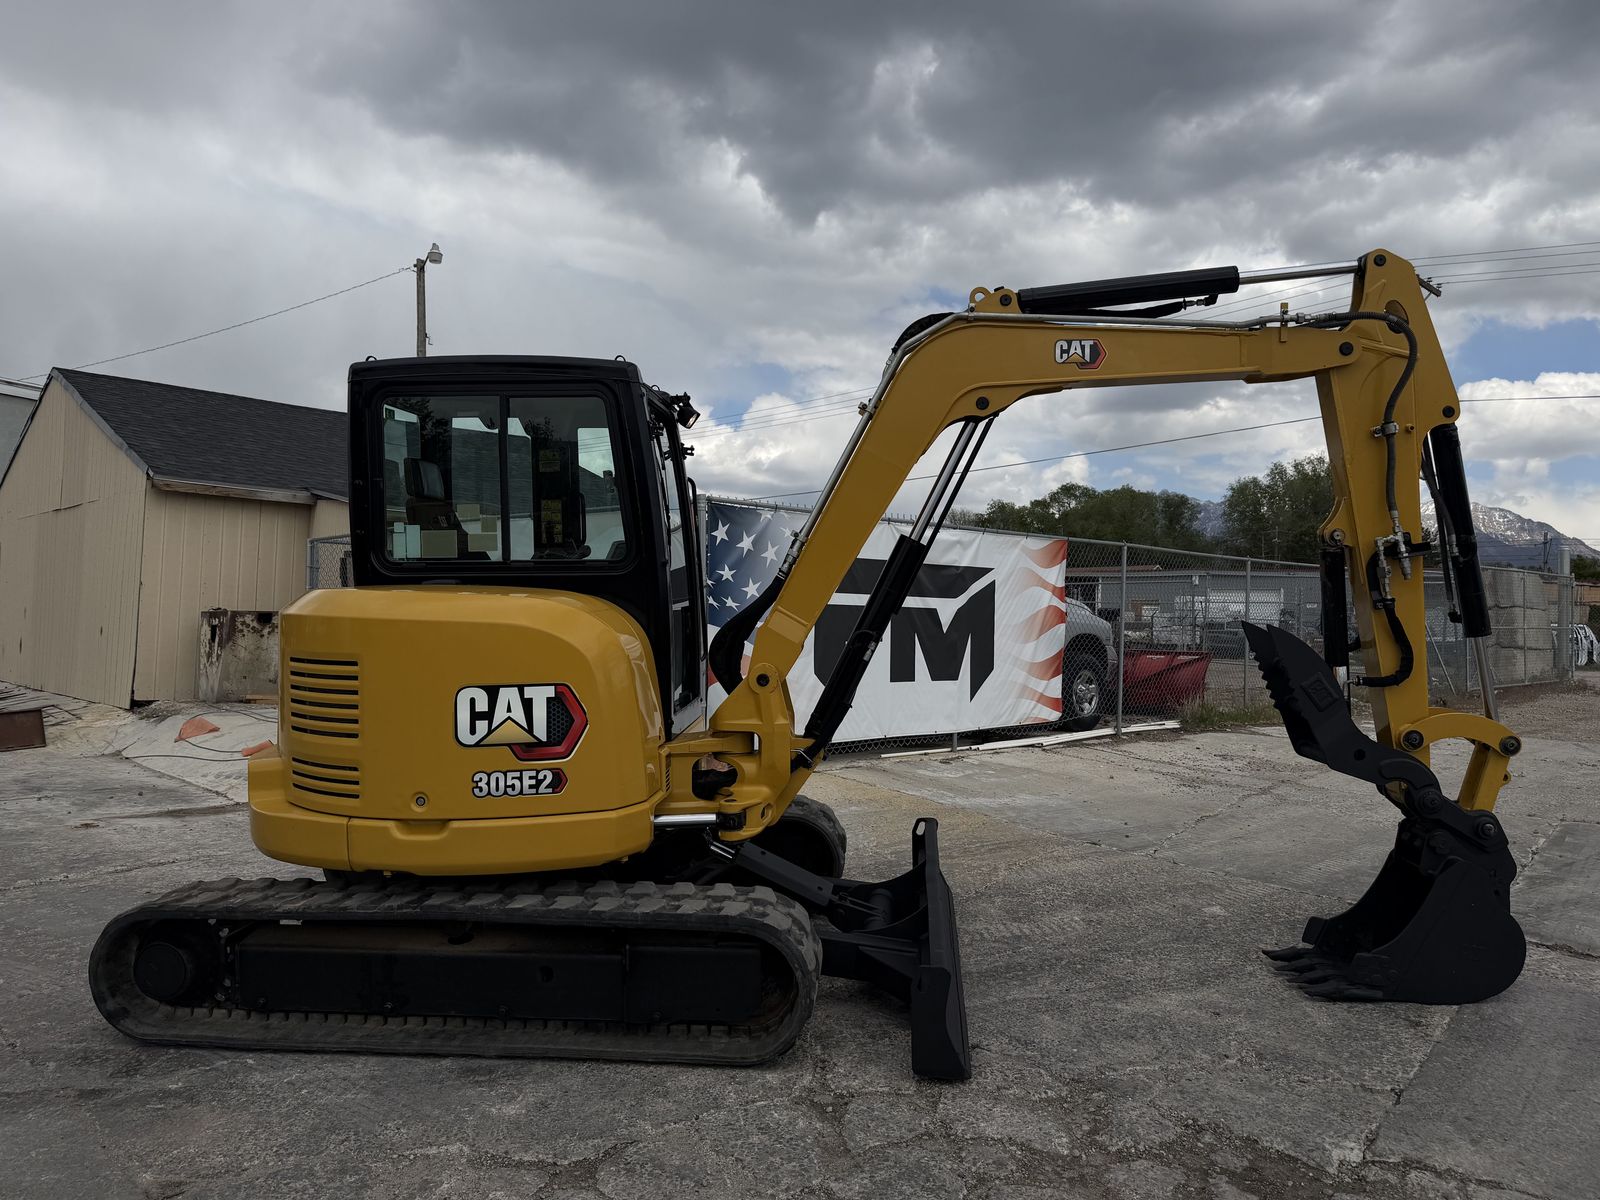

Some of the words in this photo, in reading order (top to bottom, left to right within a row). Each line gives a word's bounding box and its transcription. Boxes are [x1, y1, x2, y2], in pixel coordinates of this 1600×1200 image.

[1055, 340, 1094, 364] CAT
[456, 685, 556, 746] CAT
[473, 769, 554, 797] 305E2
